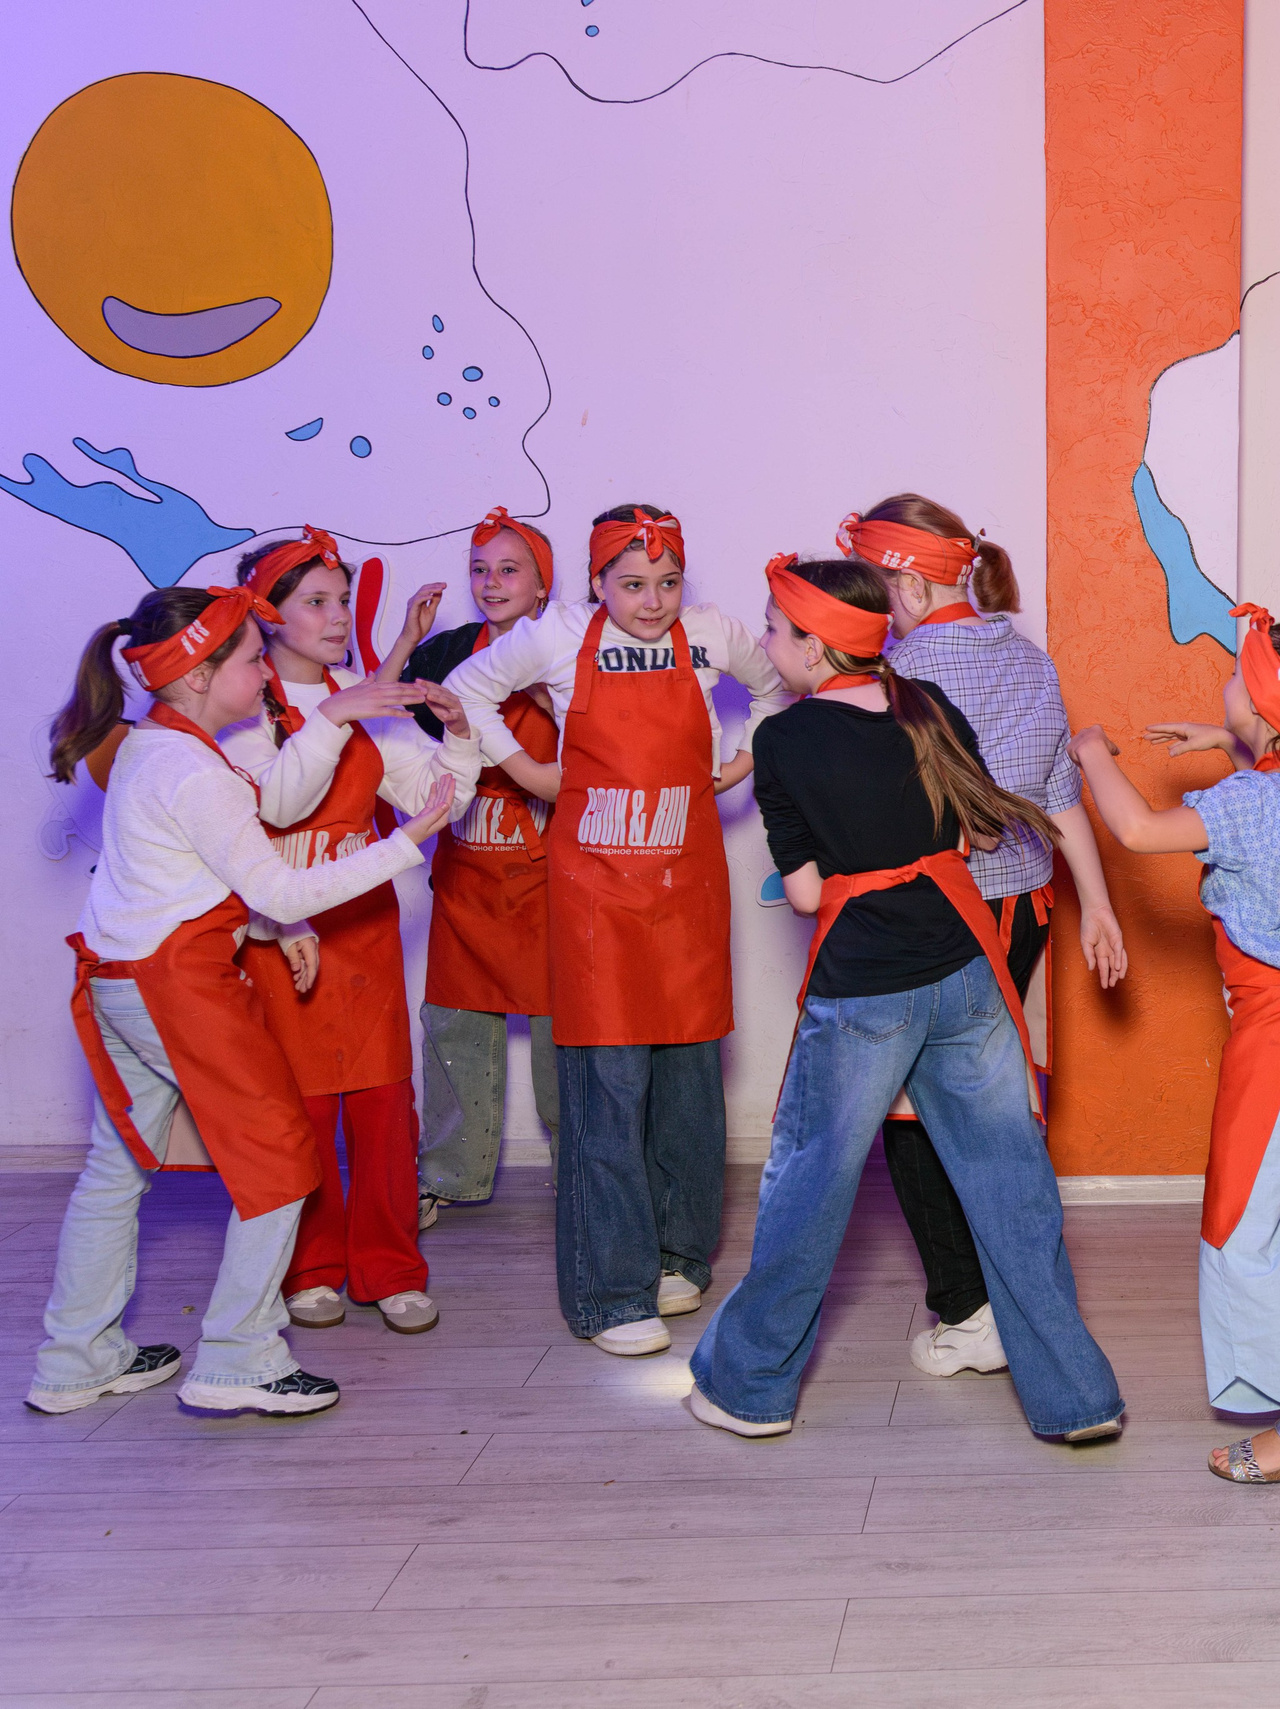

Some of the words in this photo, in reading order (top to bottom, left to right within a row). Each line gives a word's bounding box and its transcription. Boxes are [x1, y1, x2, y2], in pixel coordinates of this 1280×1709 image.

[594, 645, 710, 671] ONDN
[578, 787, 630, 847] COOK
[628, 790, 647, 847] &
[646, 786, 691, 847] RUN
[633, 847, 682, 856] квест-шоу
